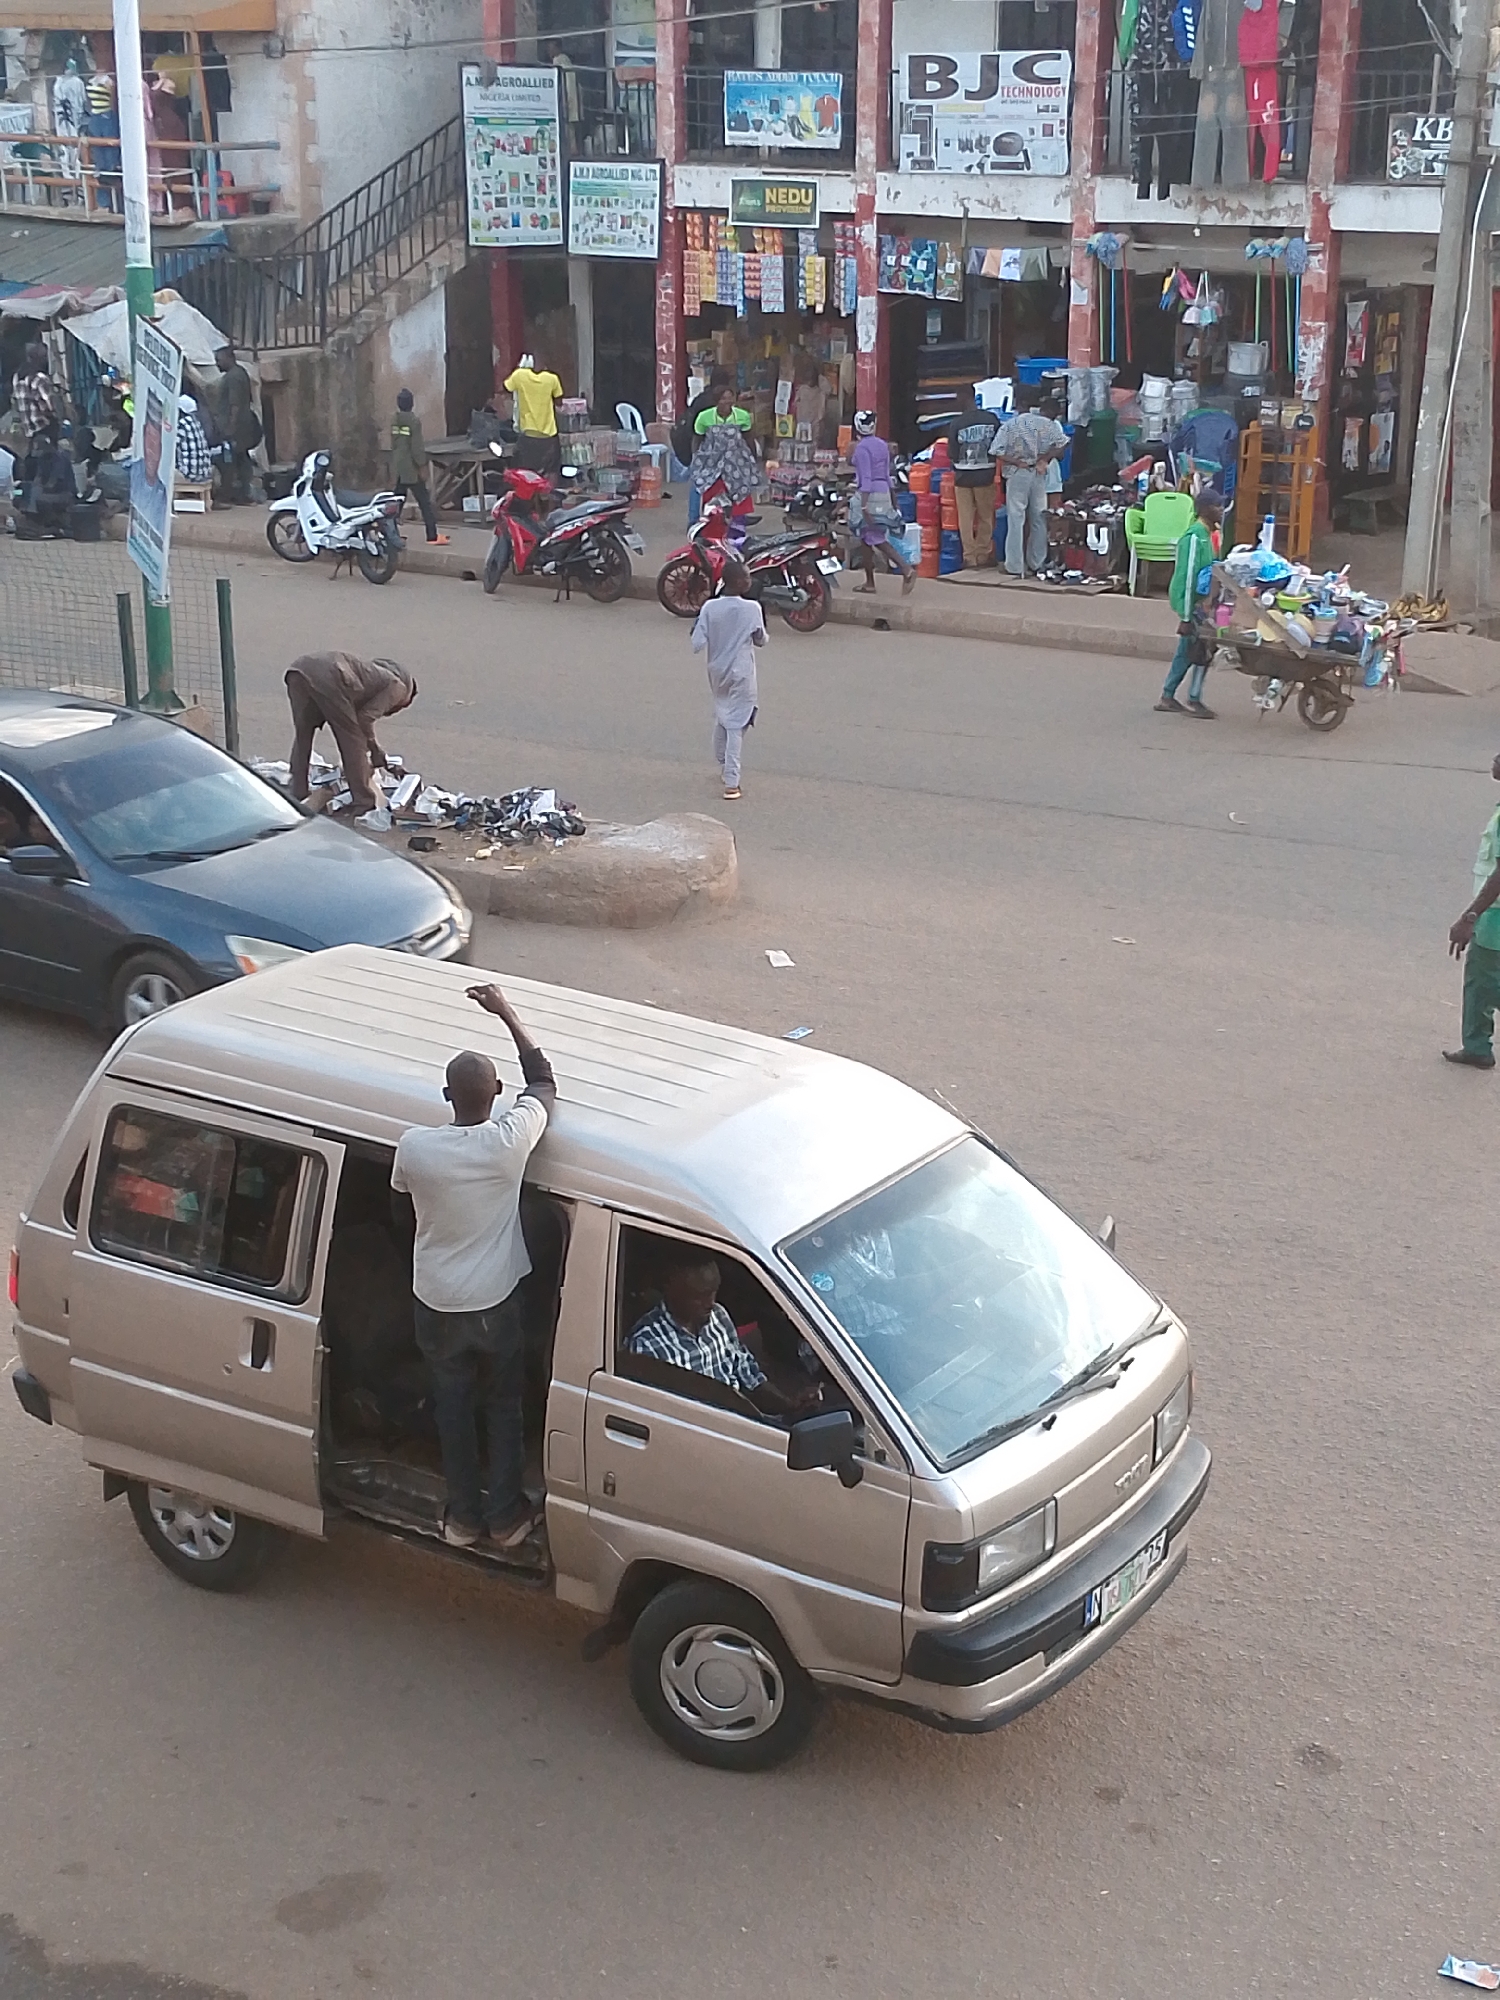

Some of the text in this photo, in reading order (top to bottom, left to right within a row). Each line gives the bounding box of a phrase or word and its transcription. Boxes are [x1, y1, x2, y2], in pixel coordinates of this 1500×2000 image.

[496, 77, 554, 88] AGROALLIED
[908, 52, 1063, 101] BJC
[1001, 86, 1067, 98] TECHNOLOGY
[765, 187, 813, 205] NEDU
